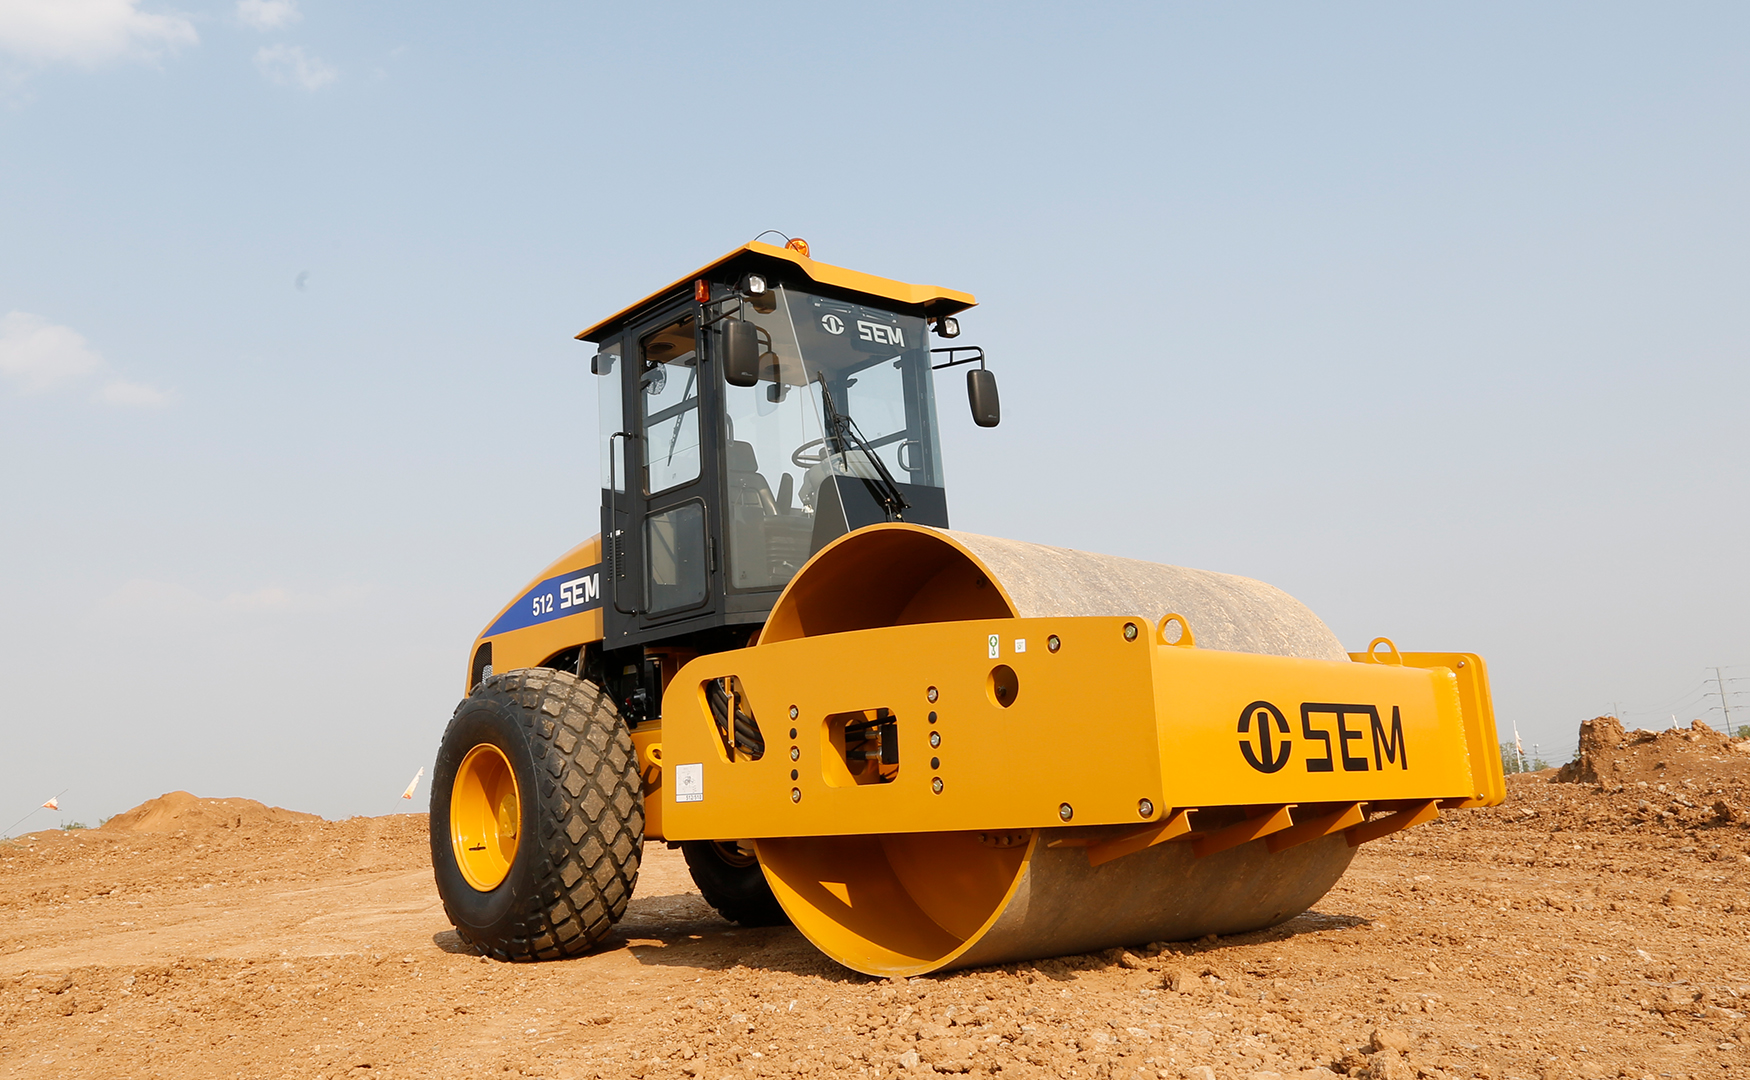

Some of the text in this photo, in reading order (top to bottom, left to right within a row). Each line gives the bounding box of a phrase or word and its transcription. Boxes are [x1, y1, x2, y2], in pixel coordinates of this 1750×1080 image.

[857, 320, 905, 347] SEM
[532, 573, 600, 617] 512 SEM
[1300, 702, 1408, 772] SEM
